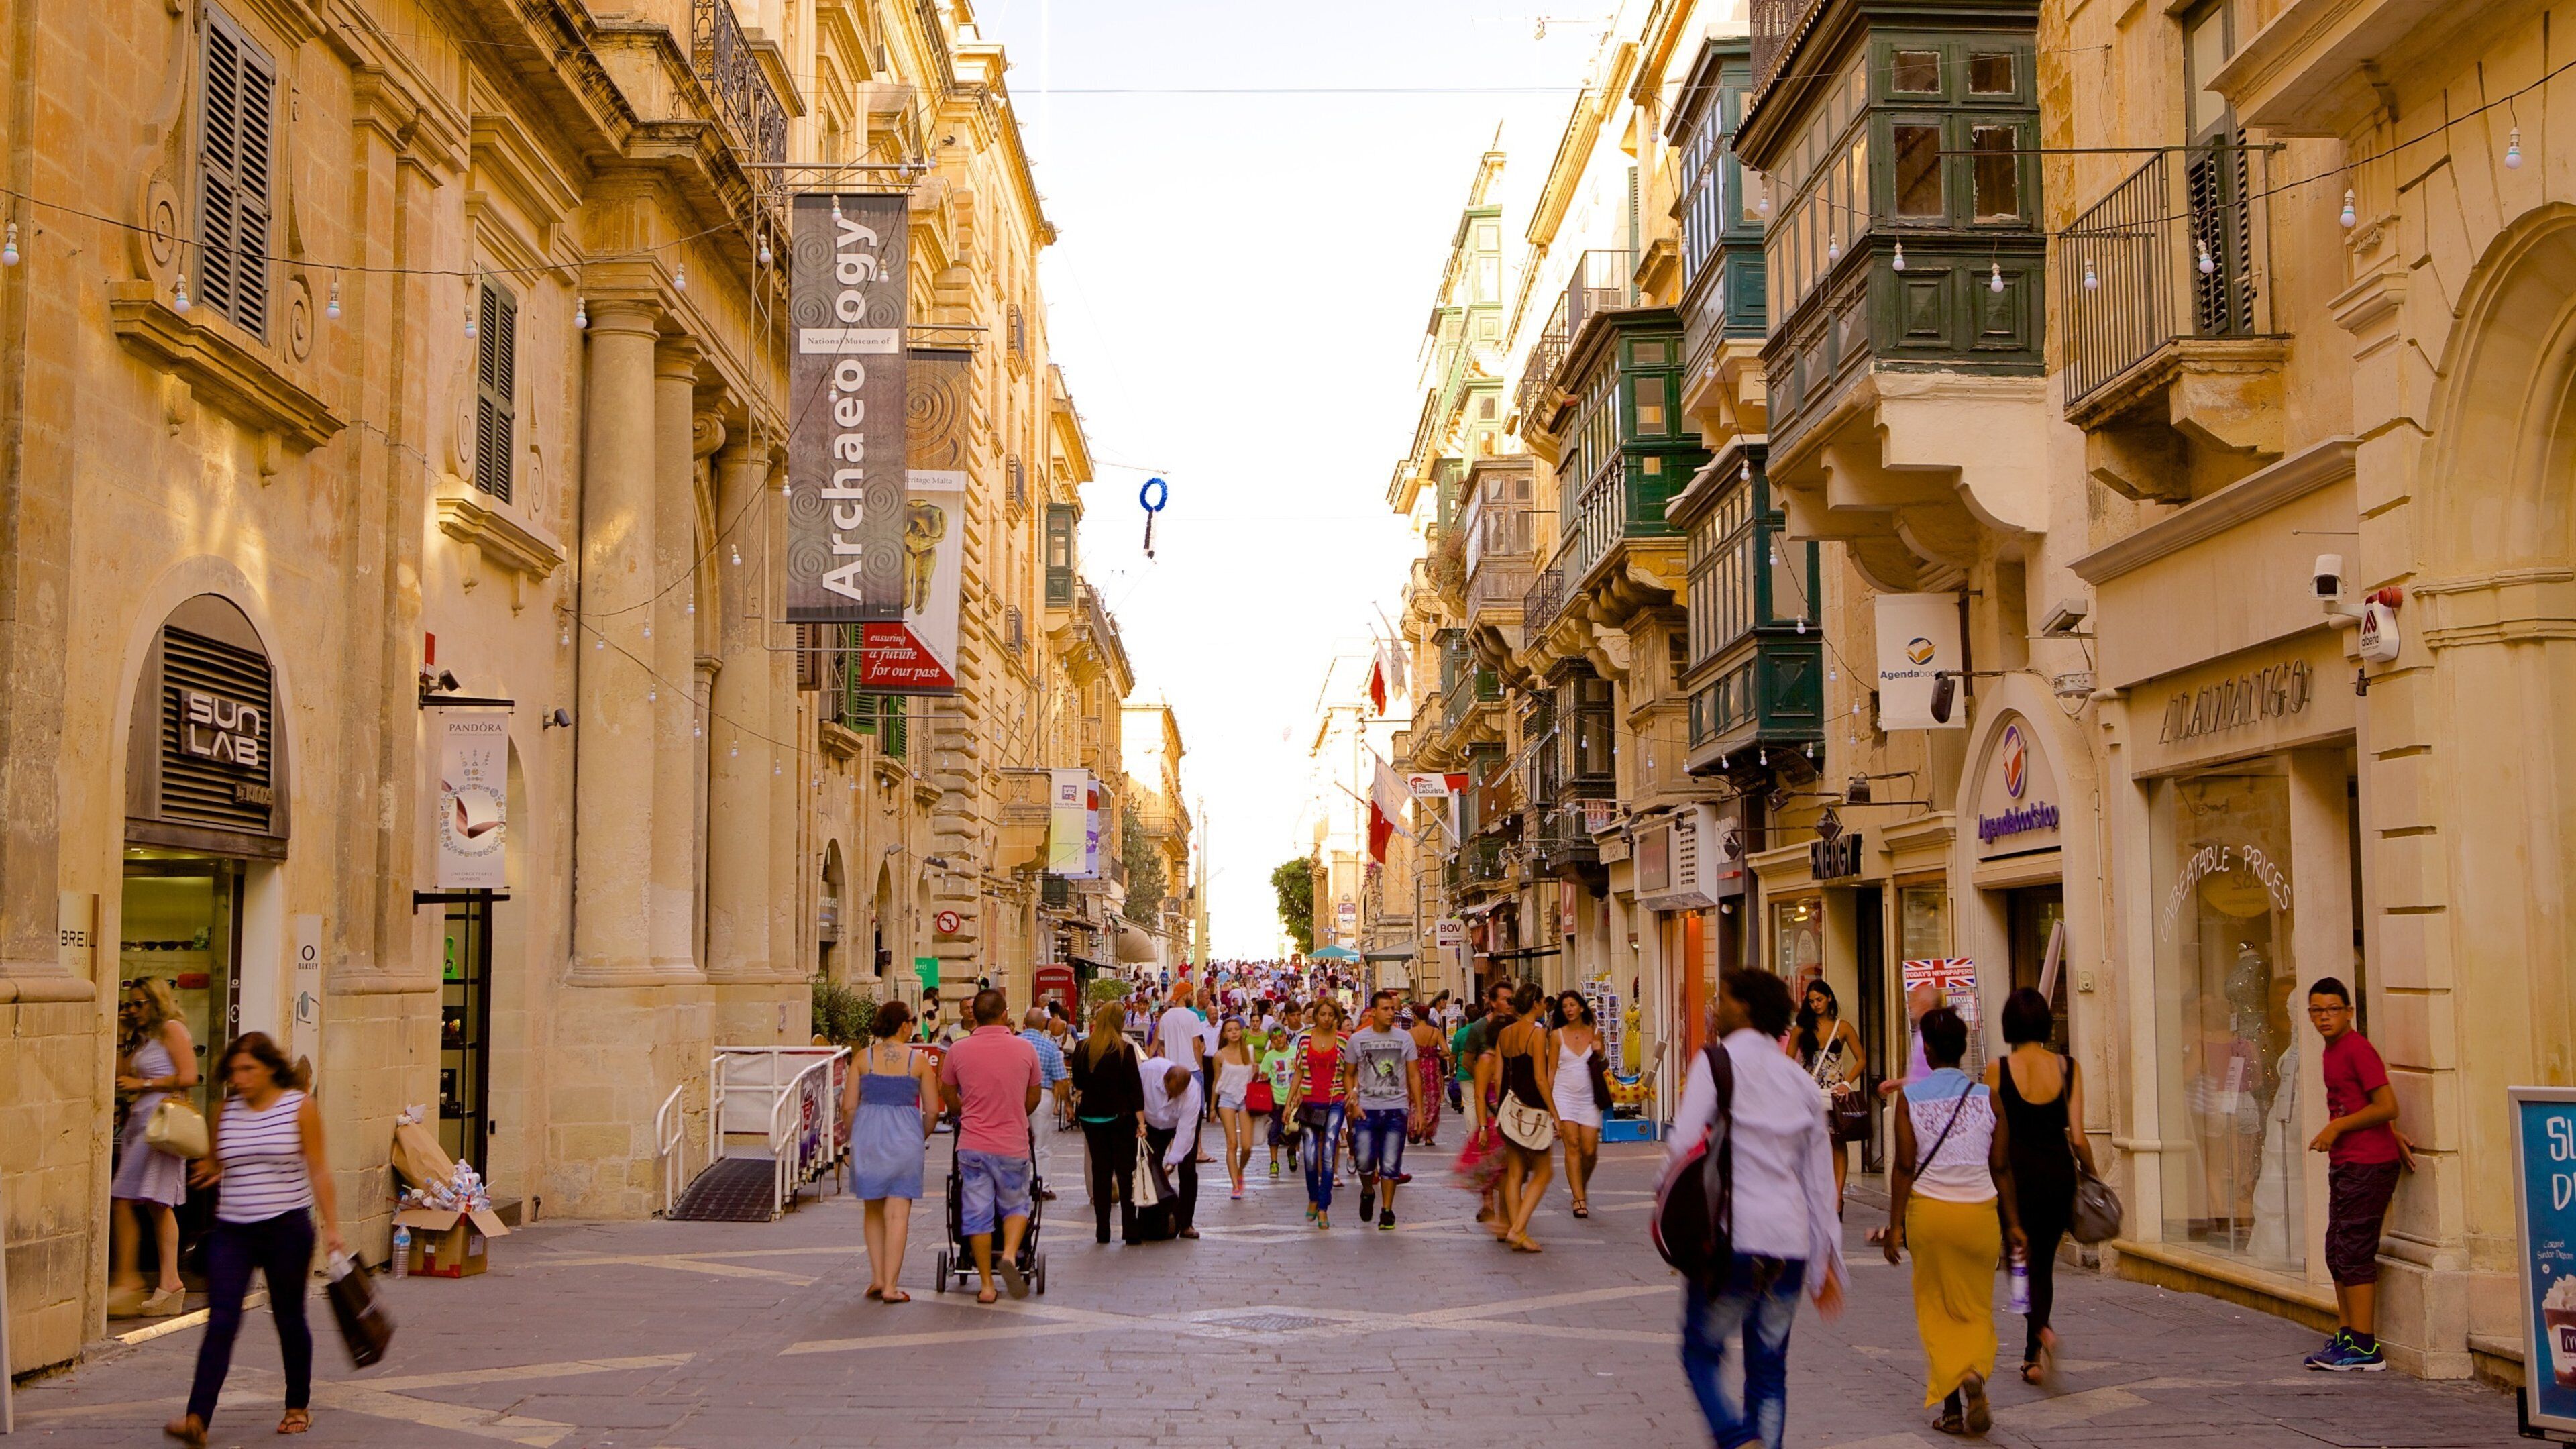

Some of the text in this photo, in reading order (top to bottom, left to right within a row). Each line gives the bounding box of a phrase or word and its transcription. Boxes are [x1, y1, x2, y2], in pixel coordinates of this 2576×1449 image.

[808, 337, 890, 345] National Museum of
[870, 633, 906, 645] ensuring
[869, 646, 917, 663] a future
[868, 662, 940, 681] for our past
[189, 692, 260, 735] SUN
[189, 724, 259, 766] LAB
[1811, 835, 1853, 881] ENERGY
[2160, 845, 2291, 943] UNBEATABLE PRICES
[1440, 924, 1462, 932] BOV
[62, 930, 96, 947] BREIL
[1905, 968, 1973, 978] TODAY'S NEWSPAPERS
[2552, 1172, 2576, 1210] D
